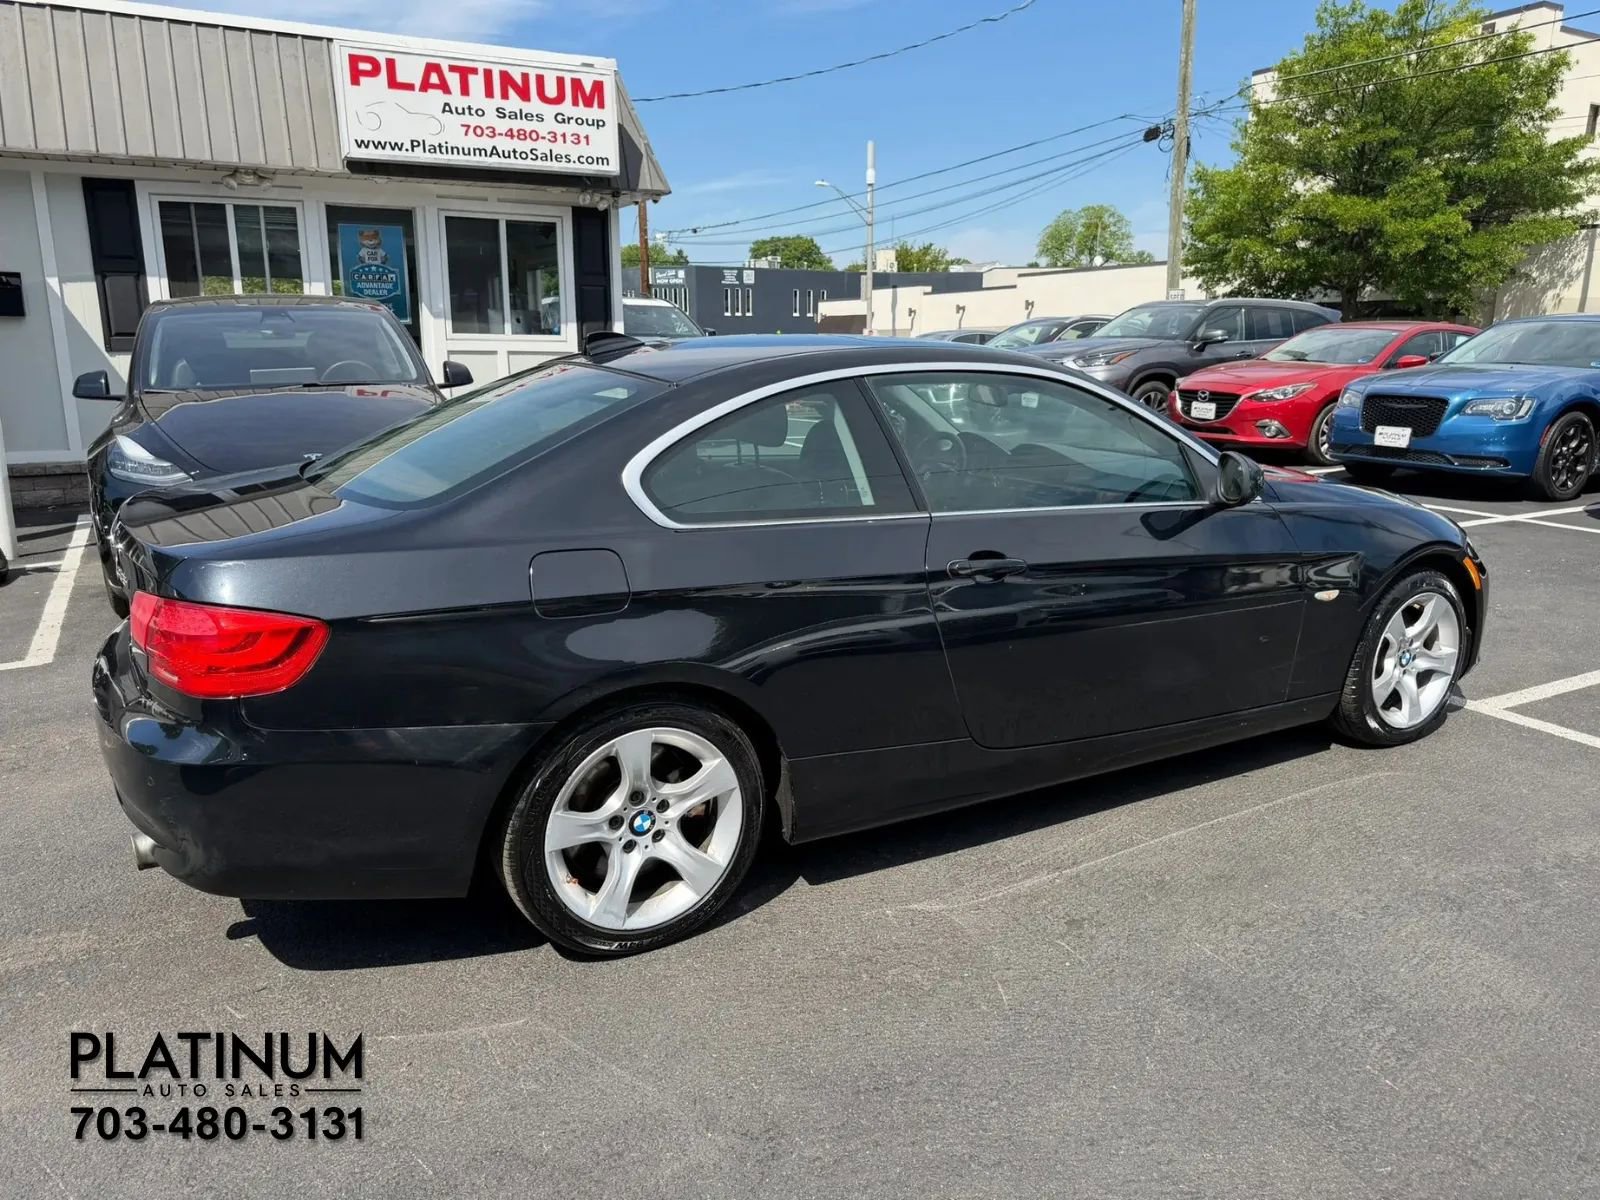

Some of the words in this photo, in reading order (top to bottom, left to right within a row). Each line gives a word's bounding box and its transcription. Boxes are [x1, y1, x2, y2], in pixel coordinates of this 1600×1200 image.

[347, 53, 606, 109] PLATINUM
[441, 102, 486, 118] Auto
[495, 106, 545, 123] Sales
[554, 112, 606, 129] Group
[460, 123, 591, 146] 703-480-3131
[354, 137, 610, 167] www.PlatinumAutoSales.com
[354, 273, 396, 281] CARFAX
